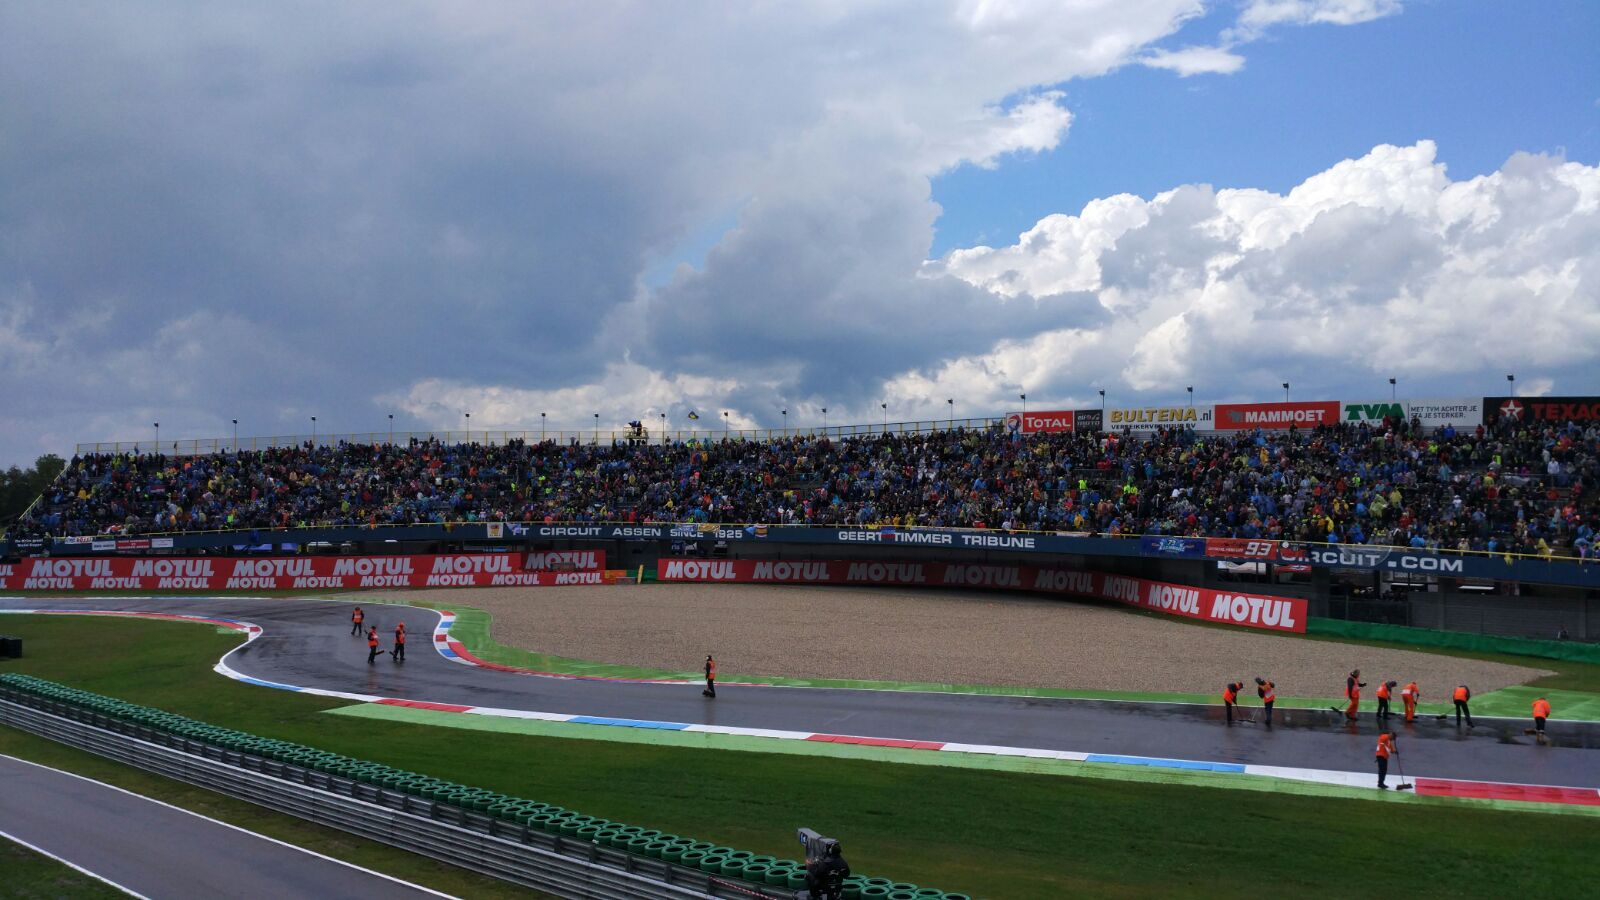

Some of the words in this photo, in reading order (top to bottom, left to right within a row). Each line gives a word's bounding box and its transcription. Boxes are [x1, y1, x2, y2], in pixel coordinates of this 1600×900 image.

[1110, 406, 1198, 423] BULTENA
[1199, 409, 1212, 421] .nl
[1245, 410, 1325, 423] MAMMOET
[1345, 403, 1405, 420] TVM
[1025, 416, 1071, 428] TOTAL
[540, 527, 602, 536] CIRCUIT
[612, 528, 661, 537] ASSEN
[669, 529, 704, 538] SINCE
[714, 529, 743, 539] 1925
[838, 531, 882, 541] GEERT
[894, 532, 952, 545] TIMMER
[962, 535, 1035, 548] TRIBUNE
[1244, 542, 1272, 556] 93
[31, 560, 113, 577] MOTUL
[131, 560, 214, 577] MOTUL
[232, 559, 315, 577] MOTUL
[333, 558, 414, 576] MOTUL
[432, 556, 512, 573] MOTUL
[525, 552, 598, 569] MOTUL
[491, 573, 540, 585] MOTUL
[555, 573, 602, 585] MOTUL
[665, 562, 736, 579] MOTUL
[753, 562, 830, 580] MOTUL
[847, 563, 926, 582] MOTUL
[944, 564, 1021, 586] MOTUL
[24, 578, 74, 589] MOTUL
[91, 578, 142, 589] MOTUL
[158, 578, 209, 589] MOTUL
[226, 577, 276, 589] MOTUL
[293, 576, 343, 588] MOTUL
[360, 575, 410, 587] MOTUL
[426, 575, 476, 586] MOTUL
[1035, 569, 1094, 593] MOTUL
[1103, 576, 1140, 603] MOTUL
[1149, 584, 1199, 615] MOTUL
[1211, 594, 1295, 628] MOTUL
